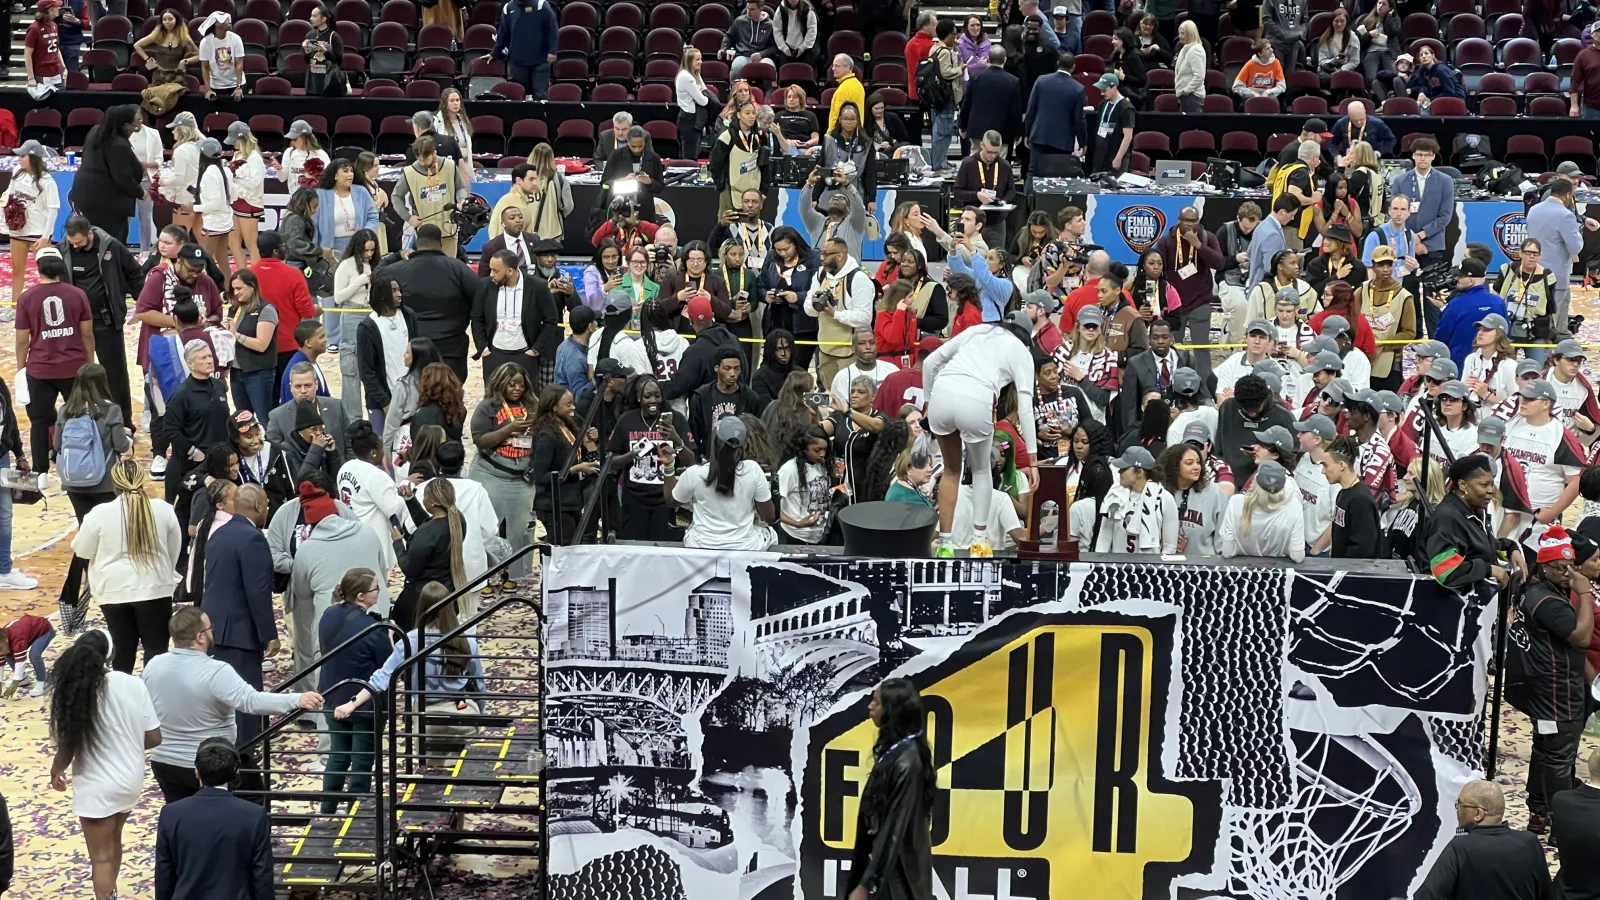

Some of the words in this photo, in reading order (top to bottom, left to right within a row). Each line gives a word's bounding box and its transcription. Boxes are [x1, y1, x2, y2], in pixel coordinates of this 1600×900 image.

[1279, 4, 1301, 15] STATE
[47, 39, 58, 53] 25
[1127, 216, 1155, 227] FINAL
[1126, 227, 1155, 238] FOUR
[191, 294, 206, 304] AL
[41, 326, 74, 340] PAOPAO
[656, 359, 678, 382] 23
[1126, 534, 1137, 554] 5
[824, 631, 1146, 855] FOUR
